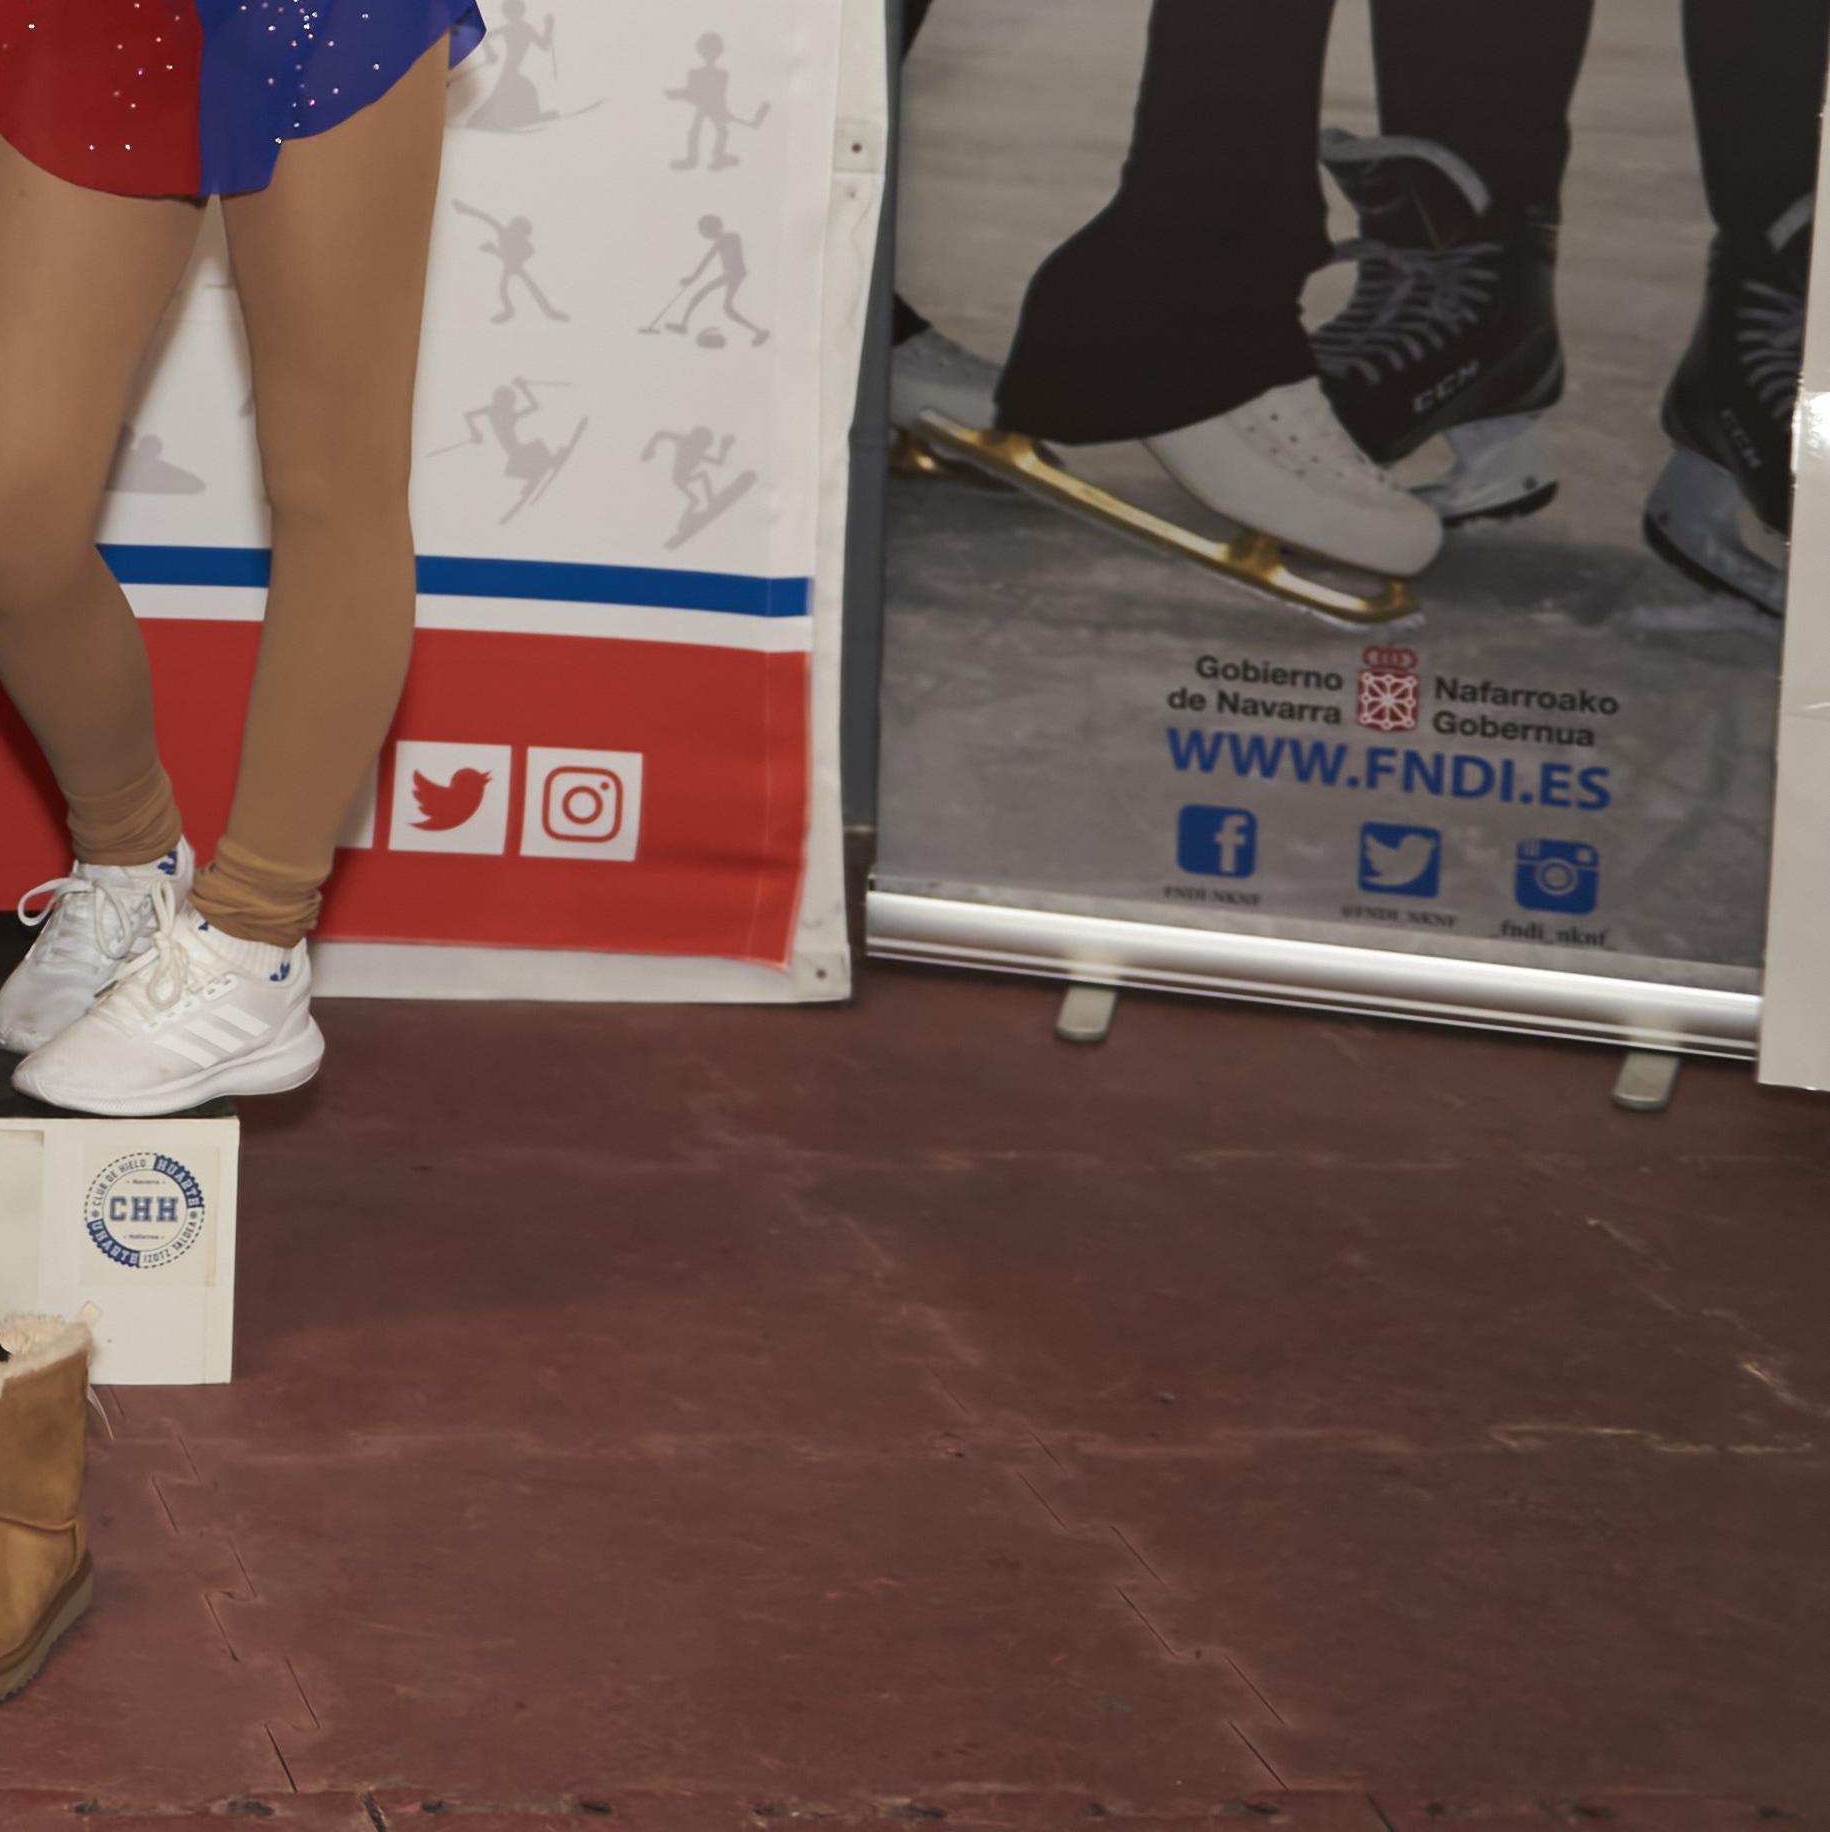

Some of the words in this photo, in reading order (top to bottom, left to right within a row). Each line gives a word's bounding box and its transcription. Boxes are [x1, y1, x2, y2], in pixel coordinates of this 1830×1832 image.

[1195, 654, 1344, 693] Gobierno
[1167, 686, 1207, 713] de
[1217, 690, 1341, 726] Navarra
[1434, 676, 1619, 716] Nafarroako
[1433, 711, 1595, 748] Gobernua
[1166, 726, 1611, 812] WWW.FNDI.ES
[110, 1196, 179, 1222] CHH
[143, 1249, 171, 1263] IZOTZ
